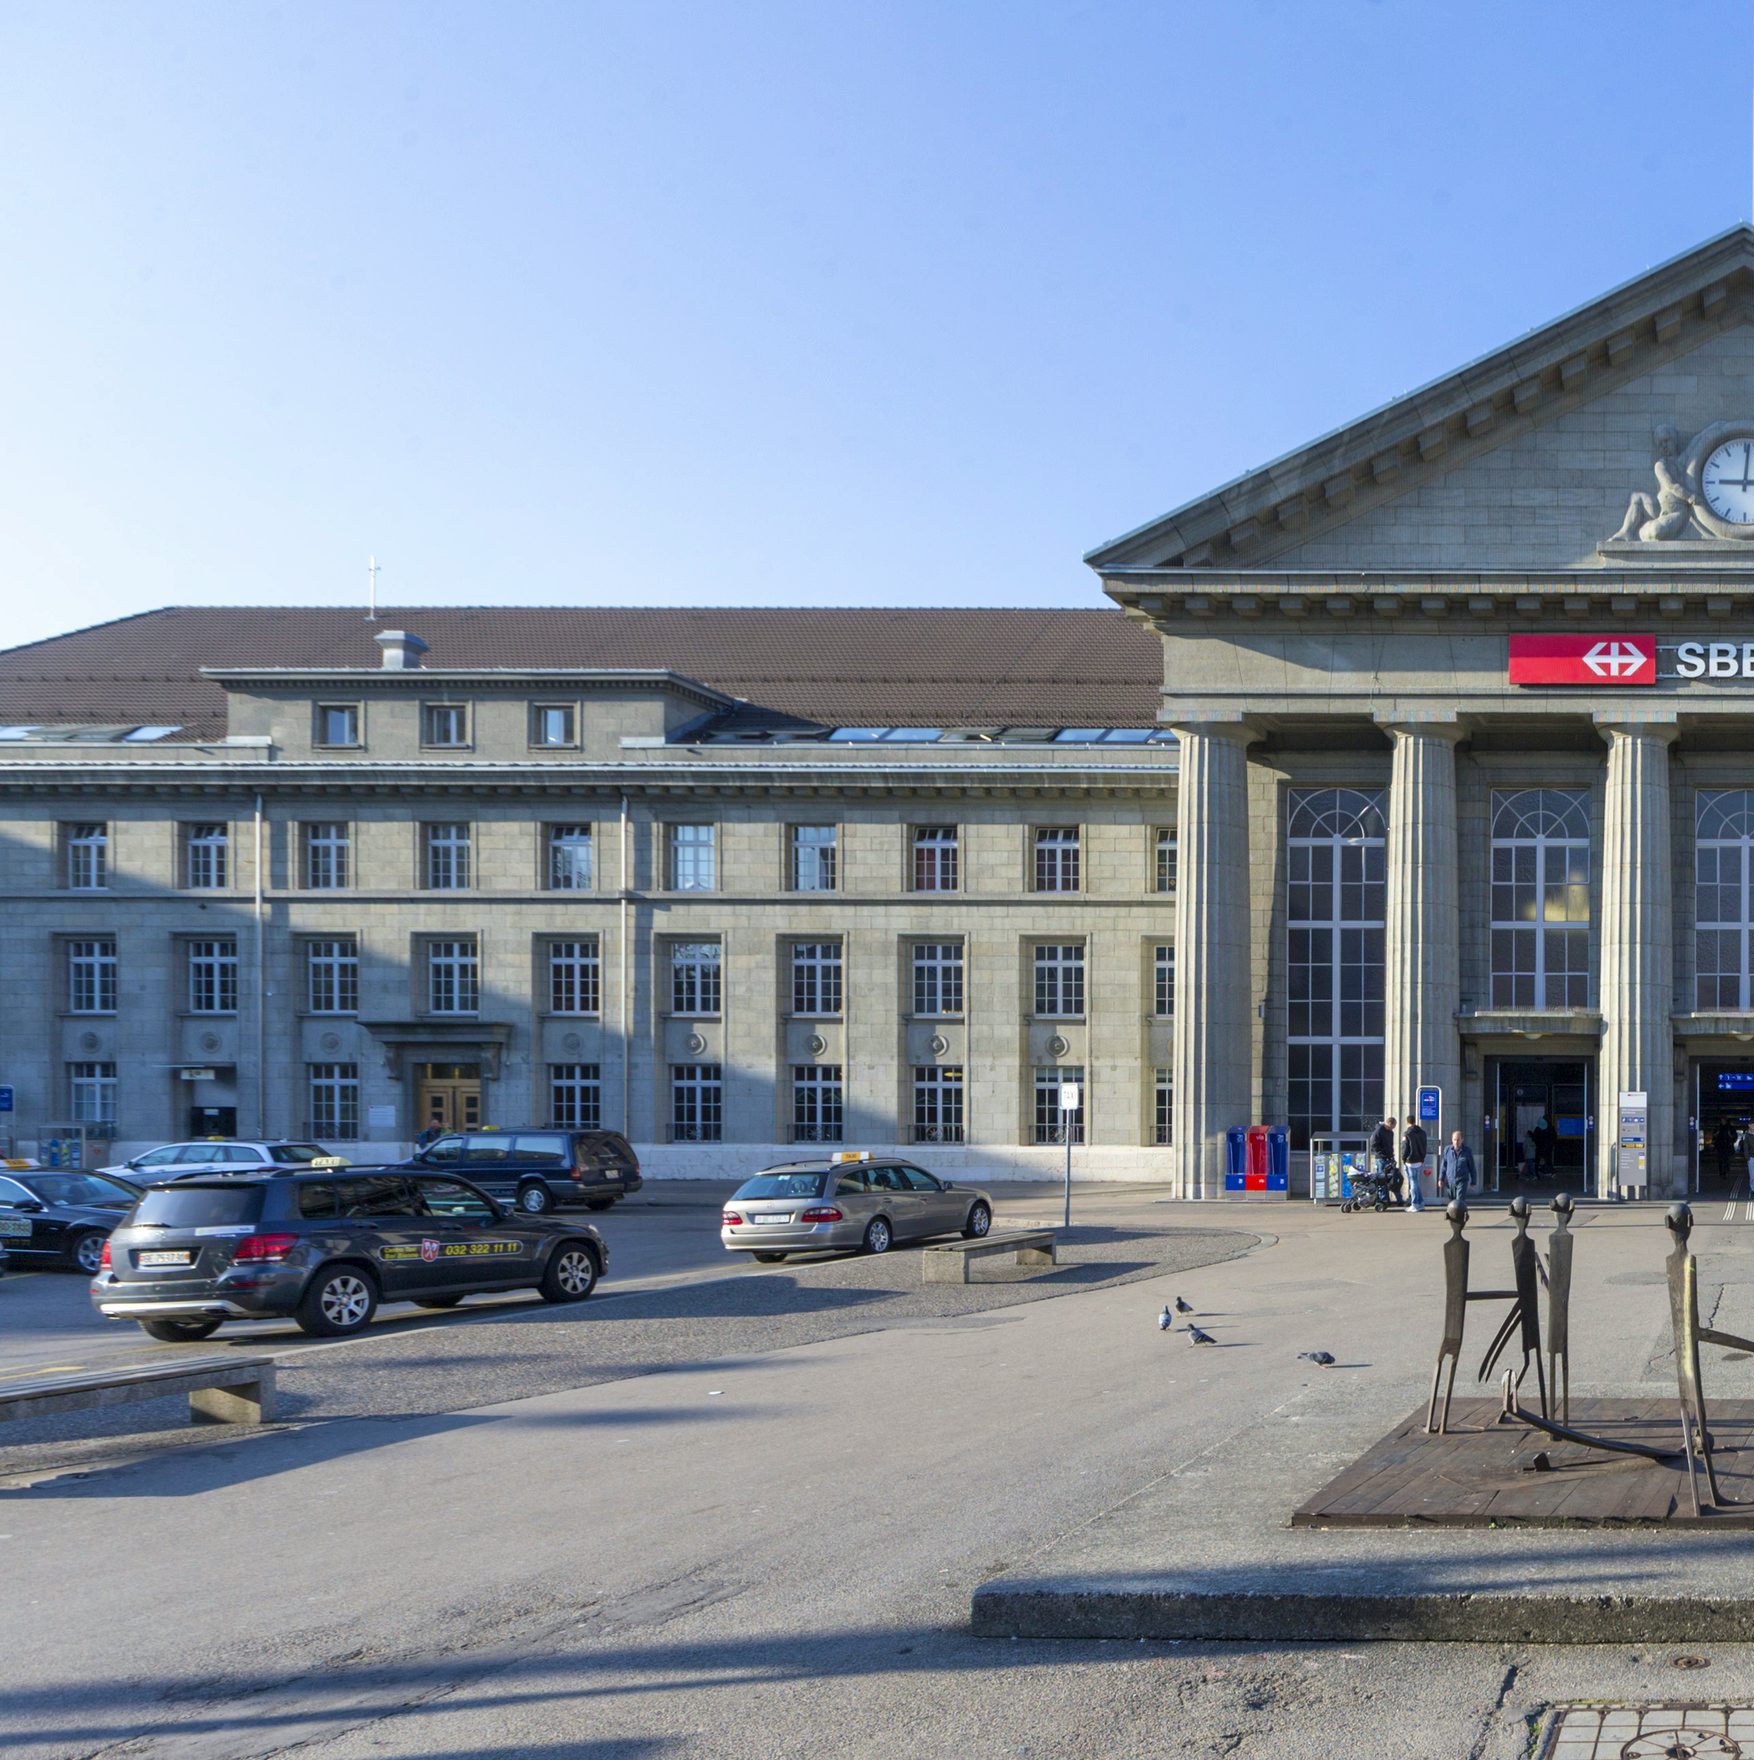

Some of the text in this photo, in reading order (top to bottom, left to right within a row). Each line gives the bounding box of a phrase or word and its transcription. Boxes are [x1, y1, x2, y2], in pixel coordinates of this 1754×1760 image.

[445, 1241, 518, 1256] 032 322 11 11
